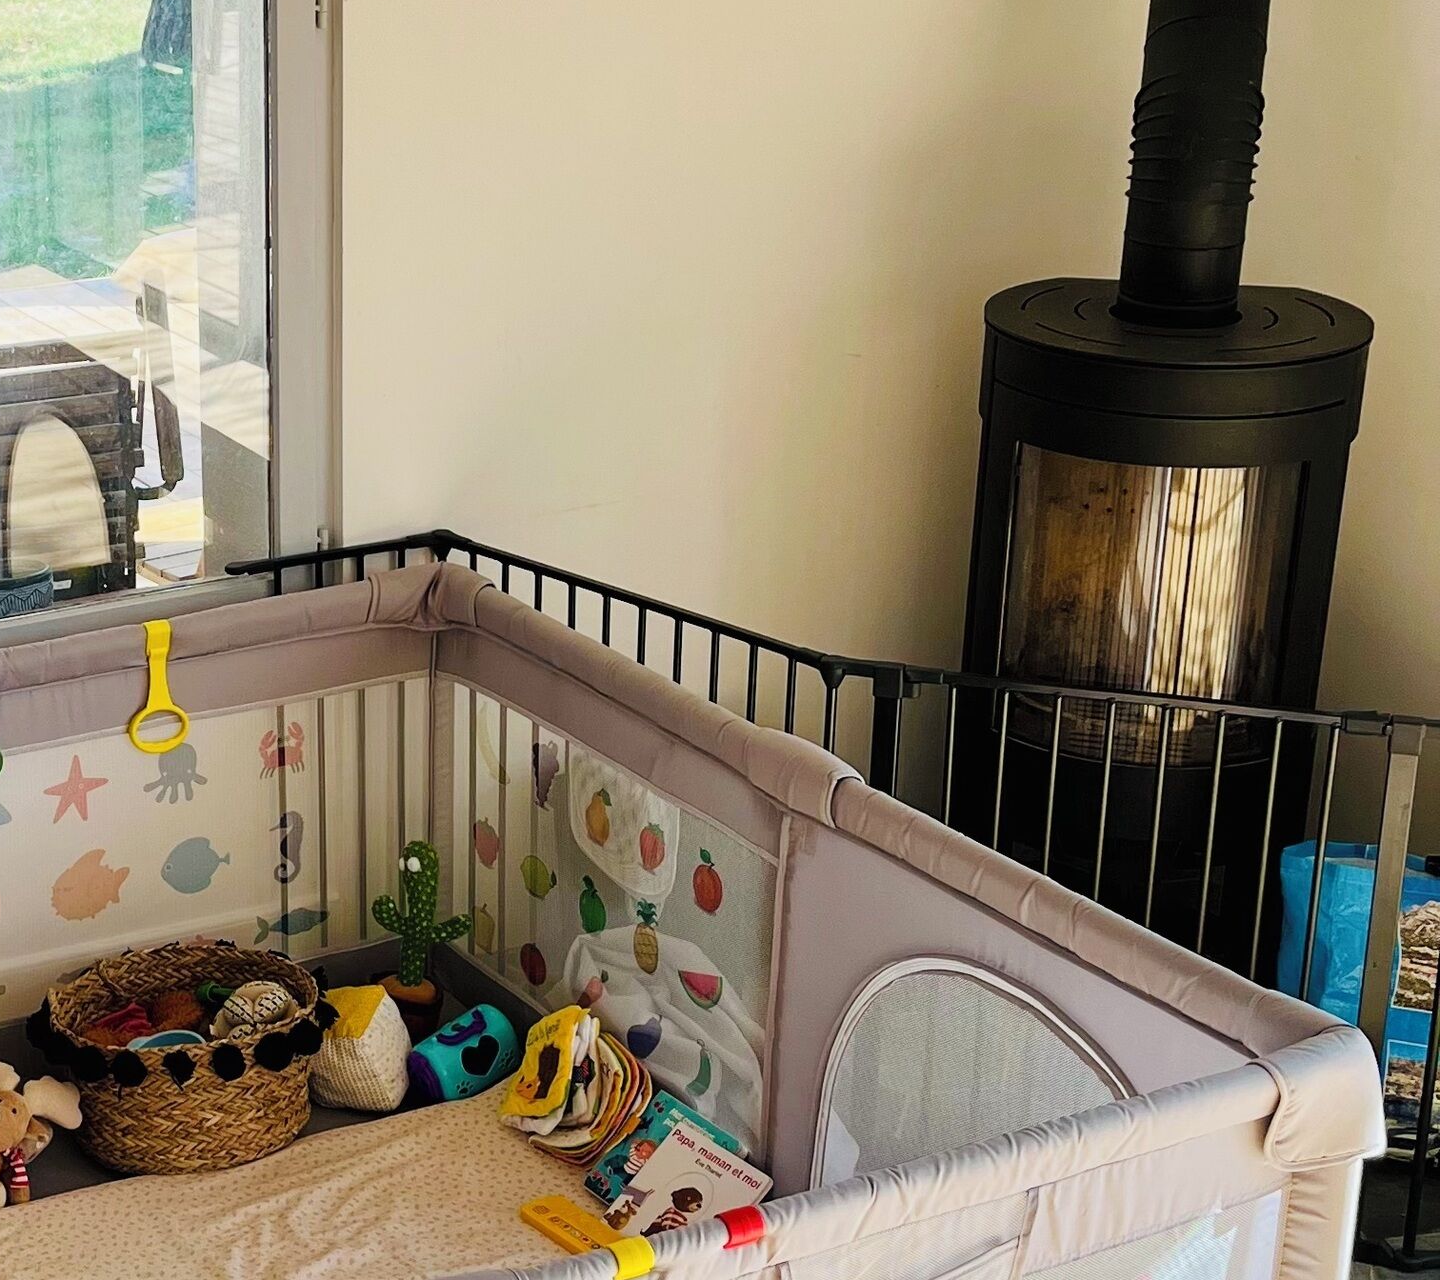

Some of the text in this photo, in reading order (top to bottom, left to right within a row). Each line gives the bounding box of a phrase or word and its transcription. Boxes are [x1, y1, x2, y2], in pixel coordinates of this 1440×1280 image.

[672, 1128, 696, 1152] Papa,
[697, 1147, 732, 1172] maman
[731, 1169, 744, 1179] et
[741, 1174, 762, 1190] moi
